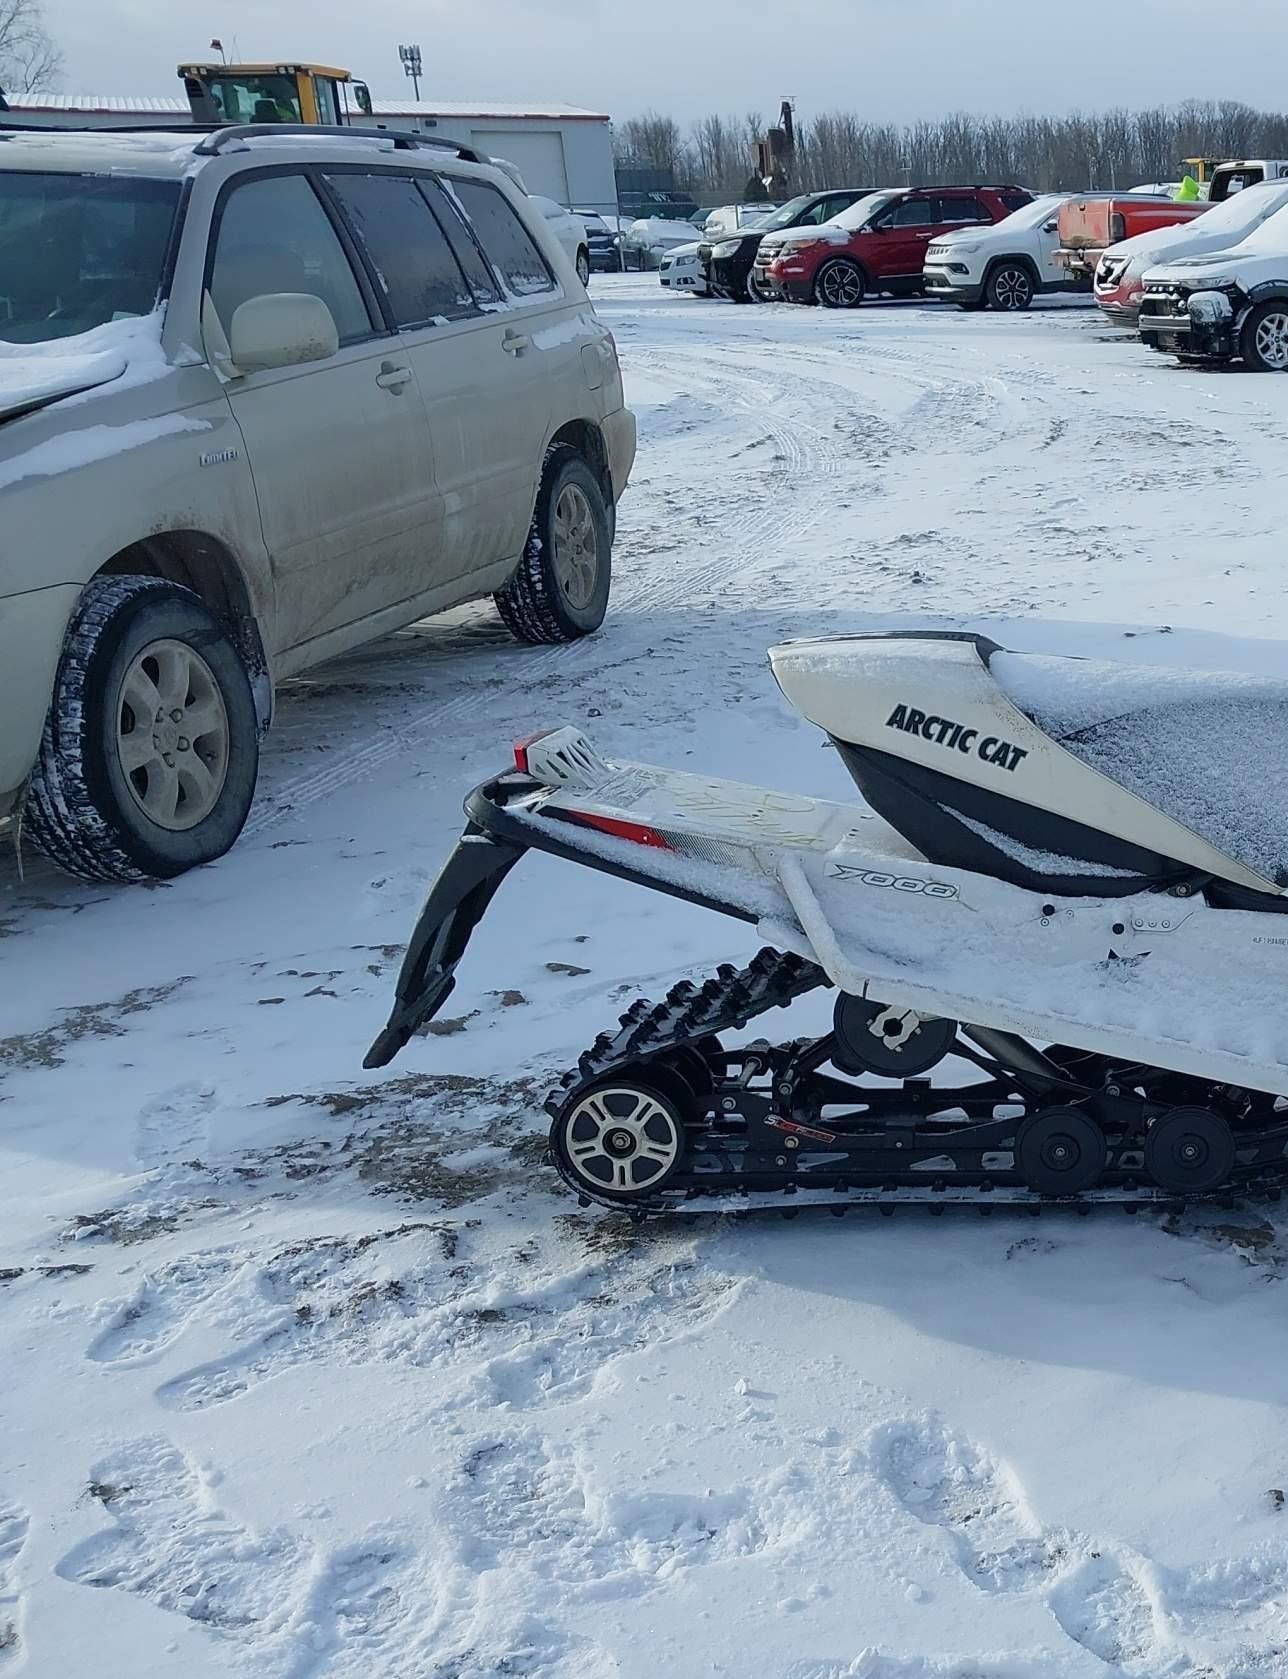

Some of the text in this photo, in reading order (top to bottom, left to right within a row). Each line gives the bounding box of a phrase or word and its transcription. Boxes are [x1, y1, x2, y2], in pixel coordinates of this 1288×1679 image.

[885, 703, 1029, 772] ARCTIC CAT
[829, 863, 958, 898] 7000
